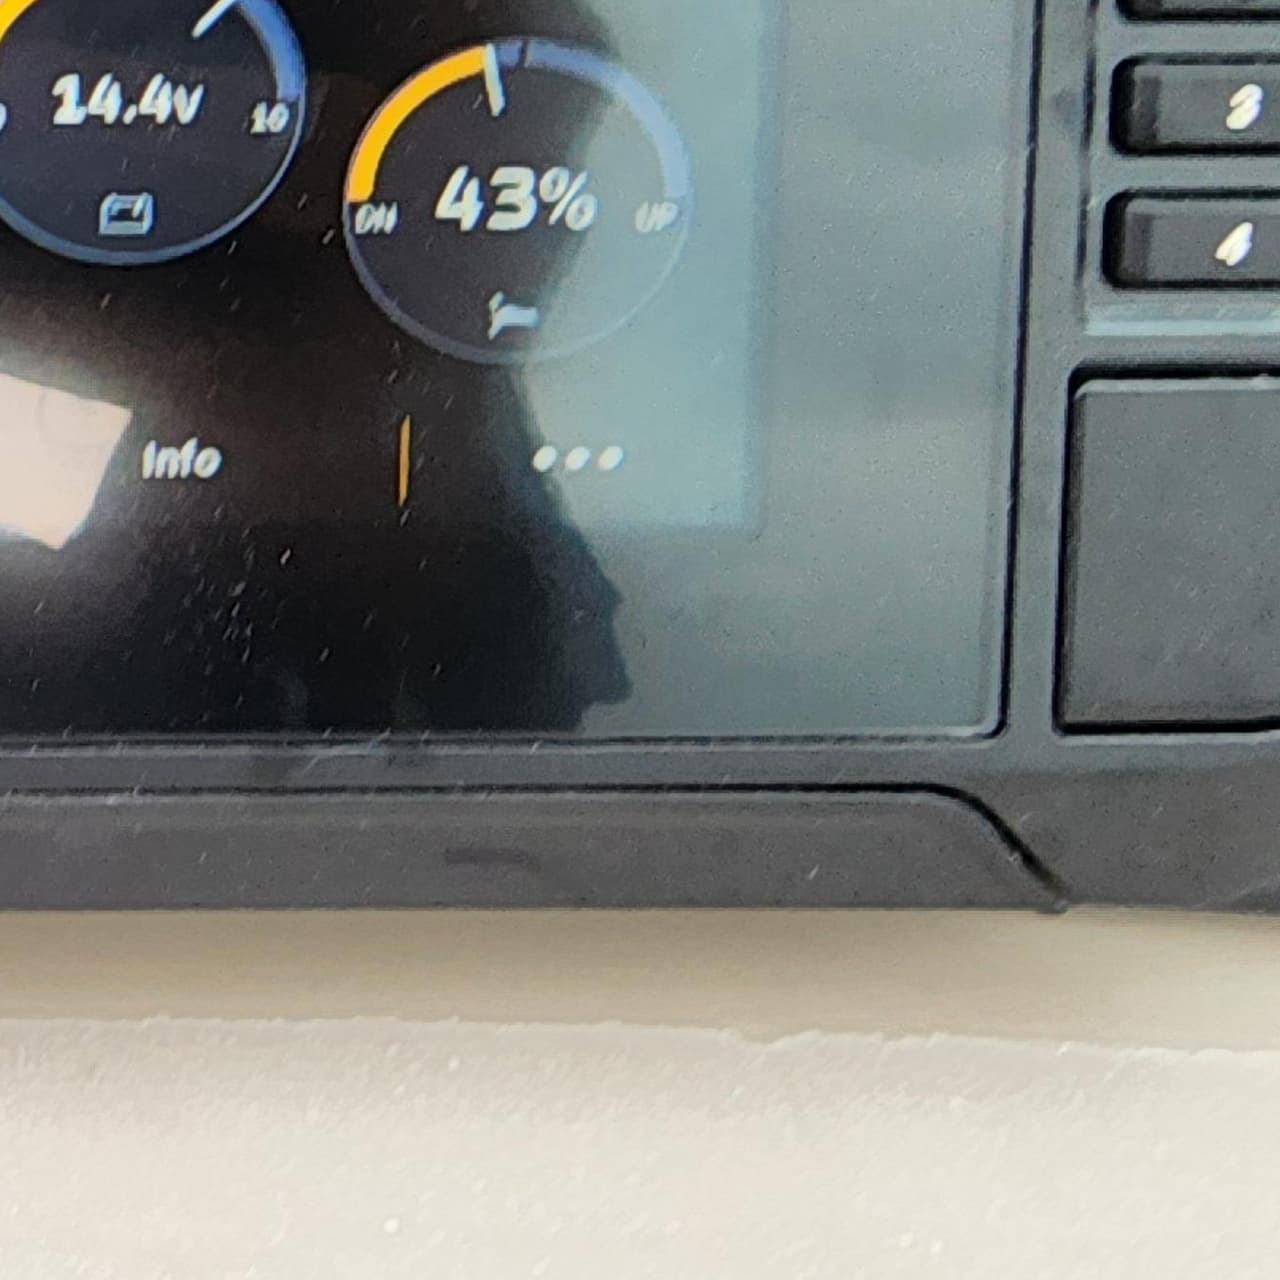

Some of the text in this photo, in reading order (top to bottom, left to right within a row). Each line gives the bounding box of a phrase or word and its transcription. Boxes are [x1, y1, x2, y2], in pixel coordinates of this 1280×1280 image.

[1226, 83, 1263, 130] 3
[435, 166, 597, 231] 43%
[635, 202, 678, 234] UP
[1215, 222, 1254, 267] 4
[142, 438, 221, 481] Info
